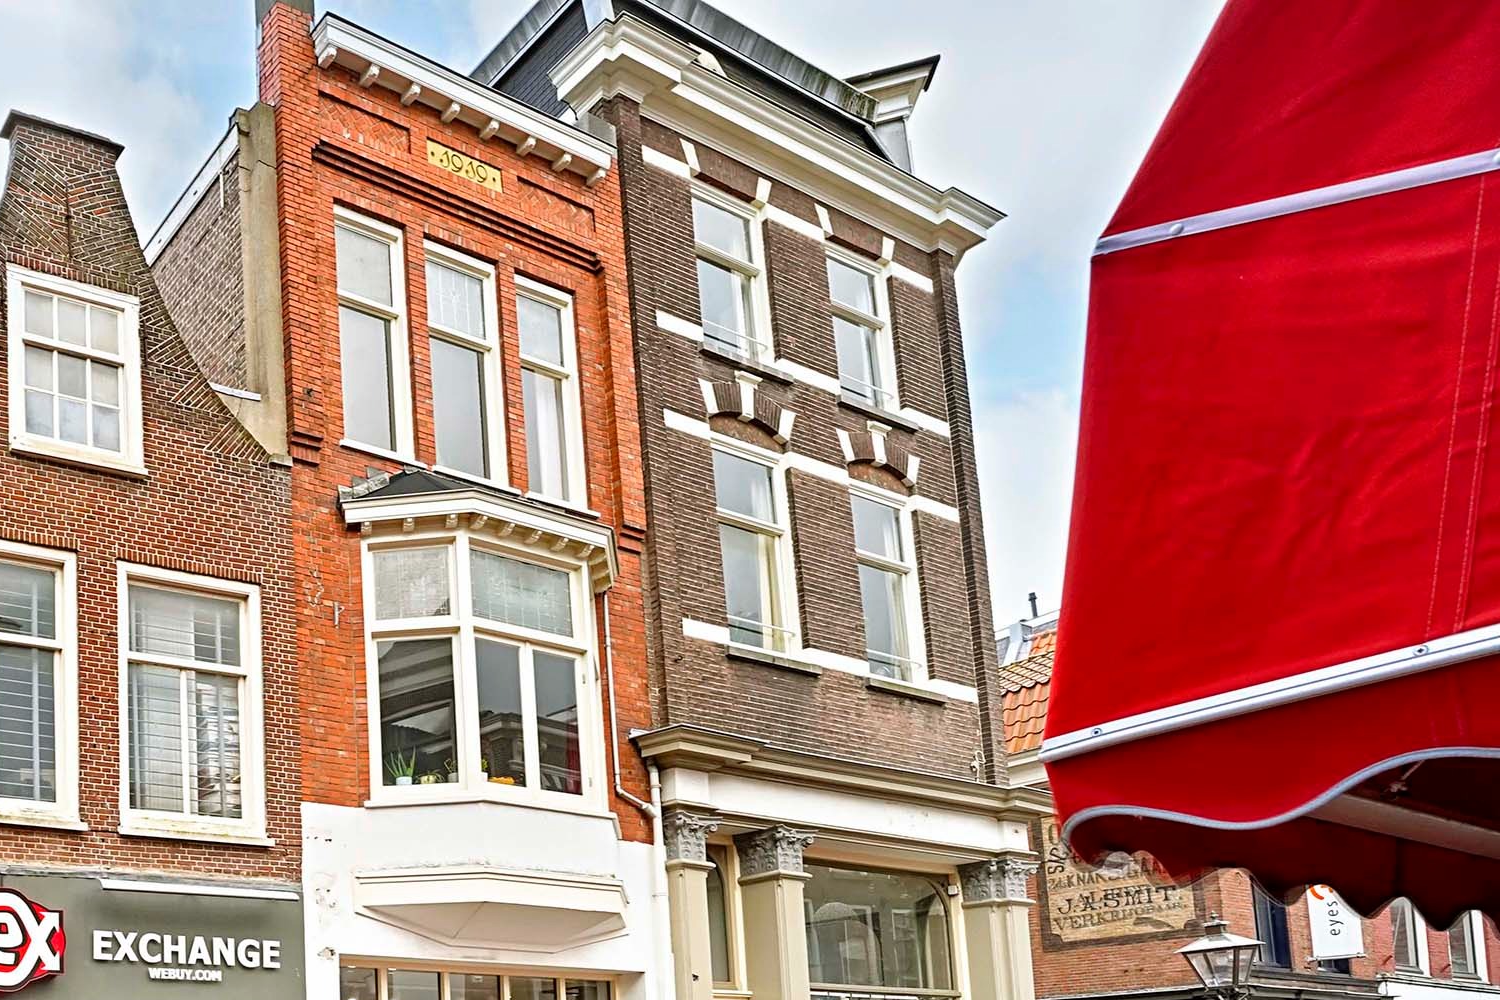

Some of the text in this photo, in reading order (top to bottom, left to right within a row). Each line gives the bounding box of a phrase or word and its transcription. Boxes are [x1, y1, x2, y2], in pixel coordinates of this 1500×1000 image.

[1327, 901, 1344, 936] eyes
[93, 930, 281, 968] EXCHANGE
[148, 967, 222, 981] WEBUY.COM
